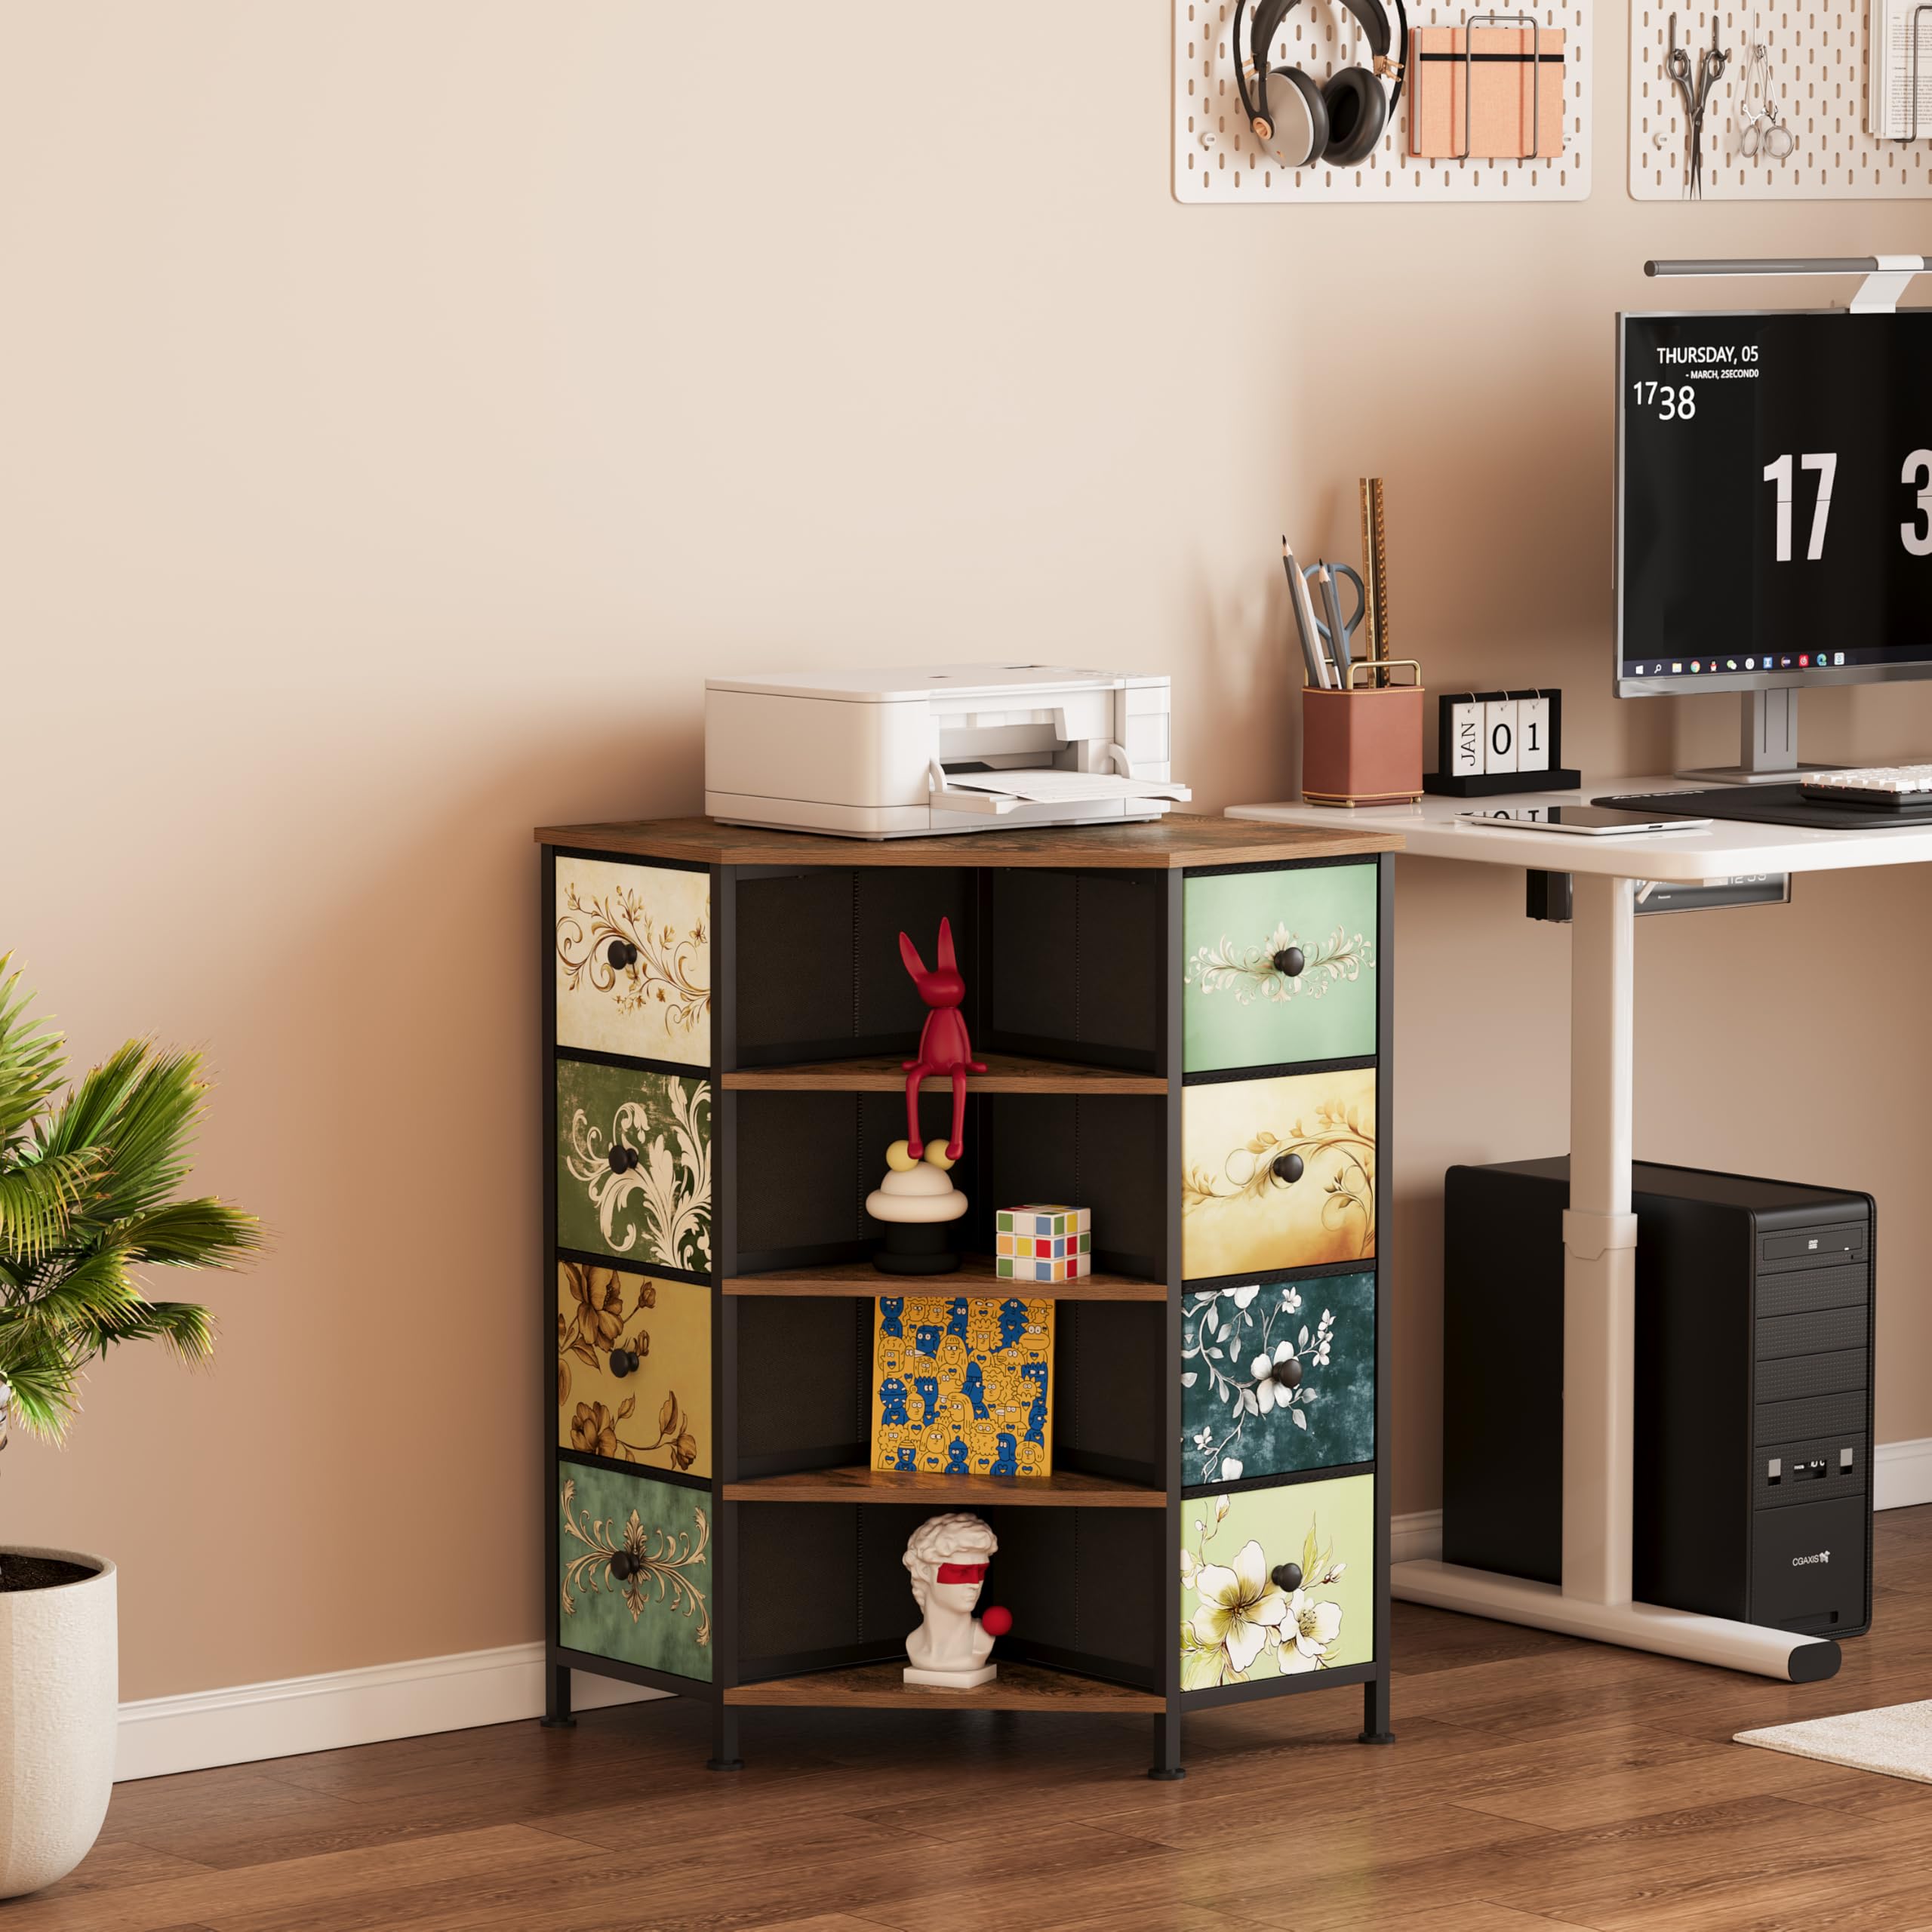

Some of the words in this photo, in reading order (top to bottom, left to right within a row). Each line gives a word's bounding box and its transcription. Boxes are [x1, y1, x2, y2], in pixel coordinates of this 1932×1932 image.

[1656, 346, 1737, 365] THURSDAY,
[1741, 345, 1759, 362] 05
[1690, 369, 1720, 380] MARCH,
[1633, 380, 1659, 405] 17
[1658, 385, 1696, 420] 38
[1763, 452, 1838, 562] 17
[1900, 448, 1932, 556] 3
[1460, 722, 1476, 767] JAN
[1792, 1554, 1820, 1567] CGAXIS
